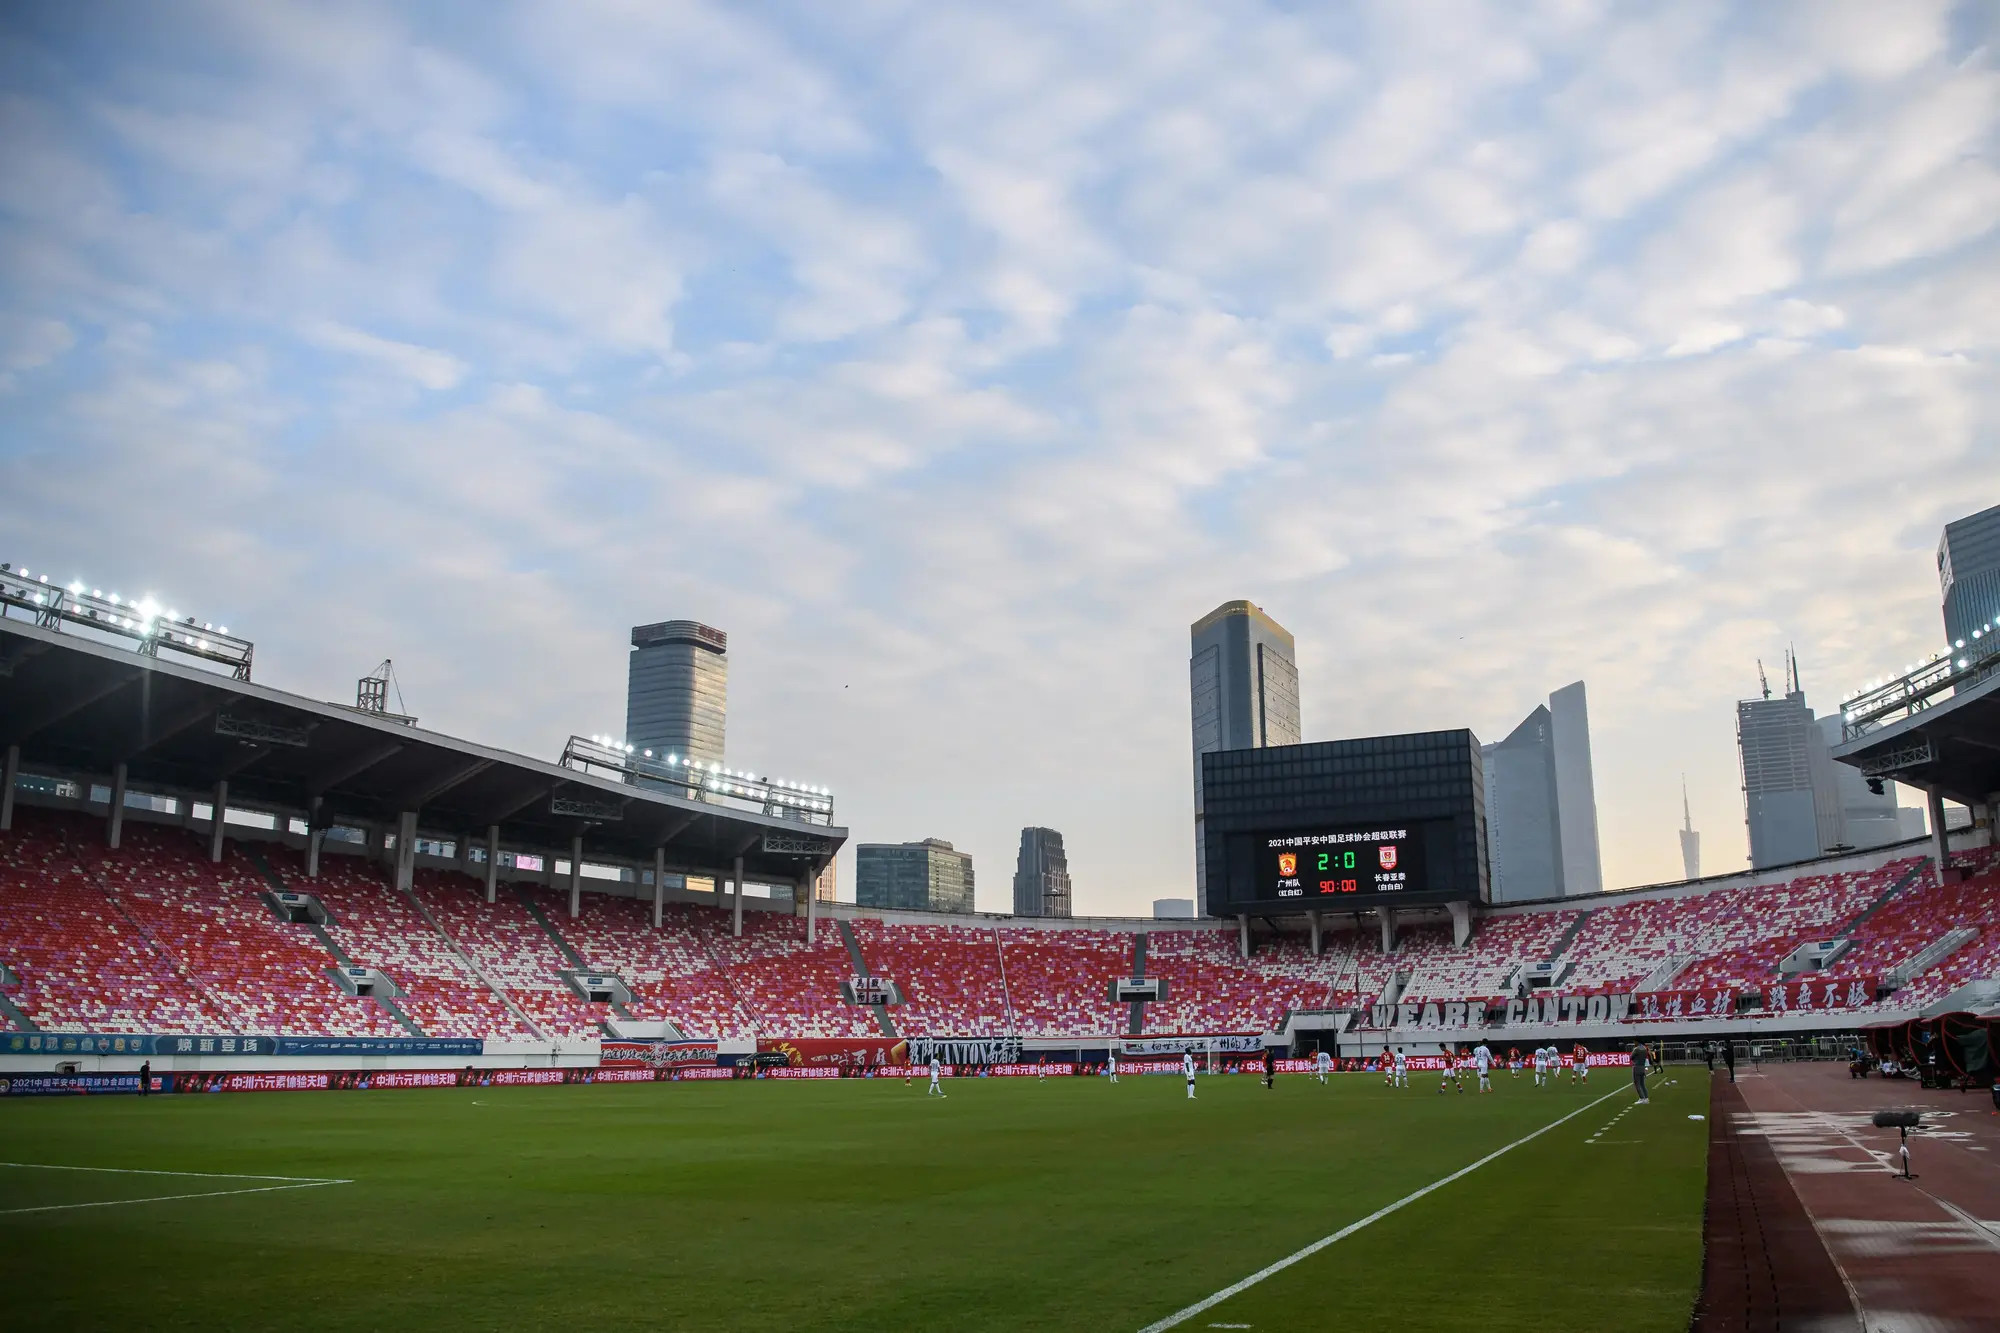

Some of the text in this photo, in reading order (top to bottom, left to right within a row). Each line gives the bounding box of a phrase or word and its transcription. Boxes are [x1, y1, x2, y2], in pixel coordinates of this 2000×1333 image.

[1268, 829, 1407, 847] 2021中国平安中国足球协会超级联赛
[1317, 851, 1356, 871] 2:0
[1277, 878, 1301, 888] 广州队
[1374, 872, 1406, 882] 长春亚泰
[1319, 879, 1357, 893] 90:00
[1505, 993, 1632, 1025] CANTON
[177, 1038, 257, 1052] 焕新登场
[880, 1066, 953, 1076] 中洲六素体地
[12, 1078, 141, 1087] 2021中国平安中国足球协会超级联
[231, 1074, 328, 1090] 中洲六元素体验天地
[376, 1072, 456, 1087] 中洲六元素体验天地
